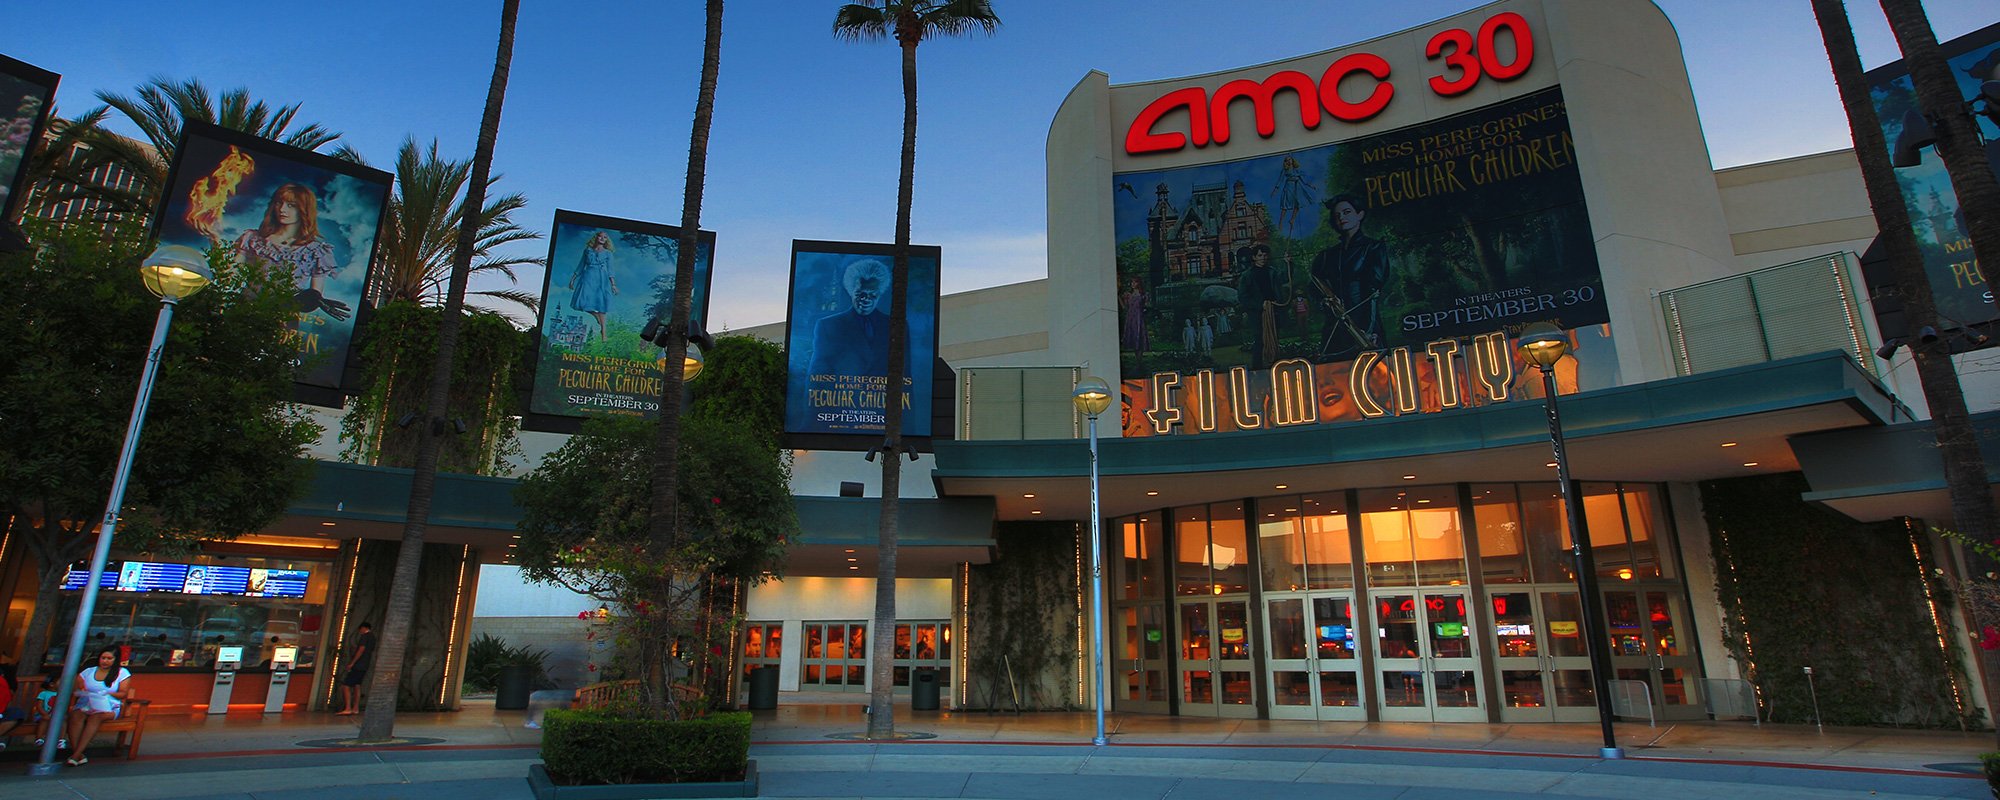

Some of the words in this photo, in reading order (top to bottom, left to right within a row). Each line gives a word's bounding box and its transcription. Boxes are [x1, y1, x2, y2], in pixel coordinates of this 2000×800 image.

[1425, 12, 1535, 98] 30
[1362, 140, 1414, 165] MISS
[1414, 143, 1474, 166] HOME
[1481, 130, 1524, 151] FOR
[1364, 159, 1467, 209] PECULIAR
[1455, 296, 1467, 306] IN
[1468, 286, 1532, 305] THEATERS
[1403, 294, 1557, 332] SEPTEMBER
[1563, 286, 1595, 306] 30
[562, 353, 592, 363] MISS
[589, 364, 621, 374] HOME
[624, 367, 646, 376] FOR
[810, 374, 836, 383] MISS
[558, 368, 612, 393] PECULIAR
[615, 374, 664, 397] CHILDRE
[1145, 357, 1318, 435] FILM
[1350, 331, 1514, 417] CITY
[567, 394, 641, 410] SEPTEMBER
[644, 402, 659, 411] 30
[808, 388, 856, 409] PECULIAR
[817, 412, 885, 424] SEPTEMBER
